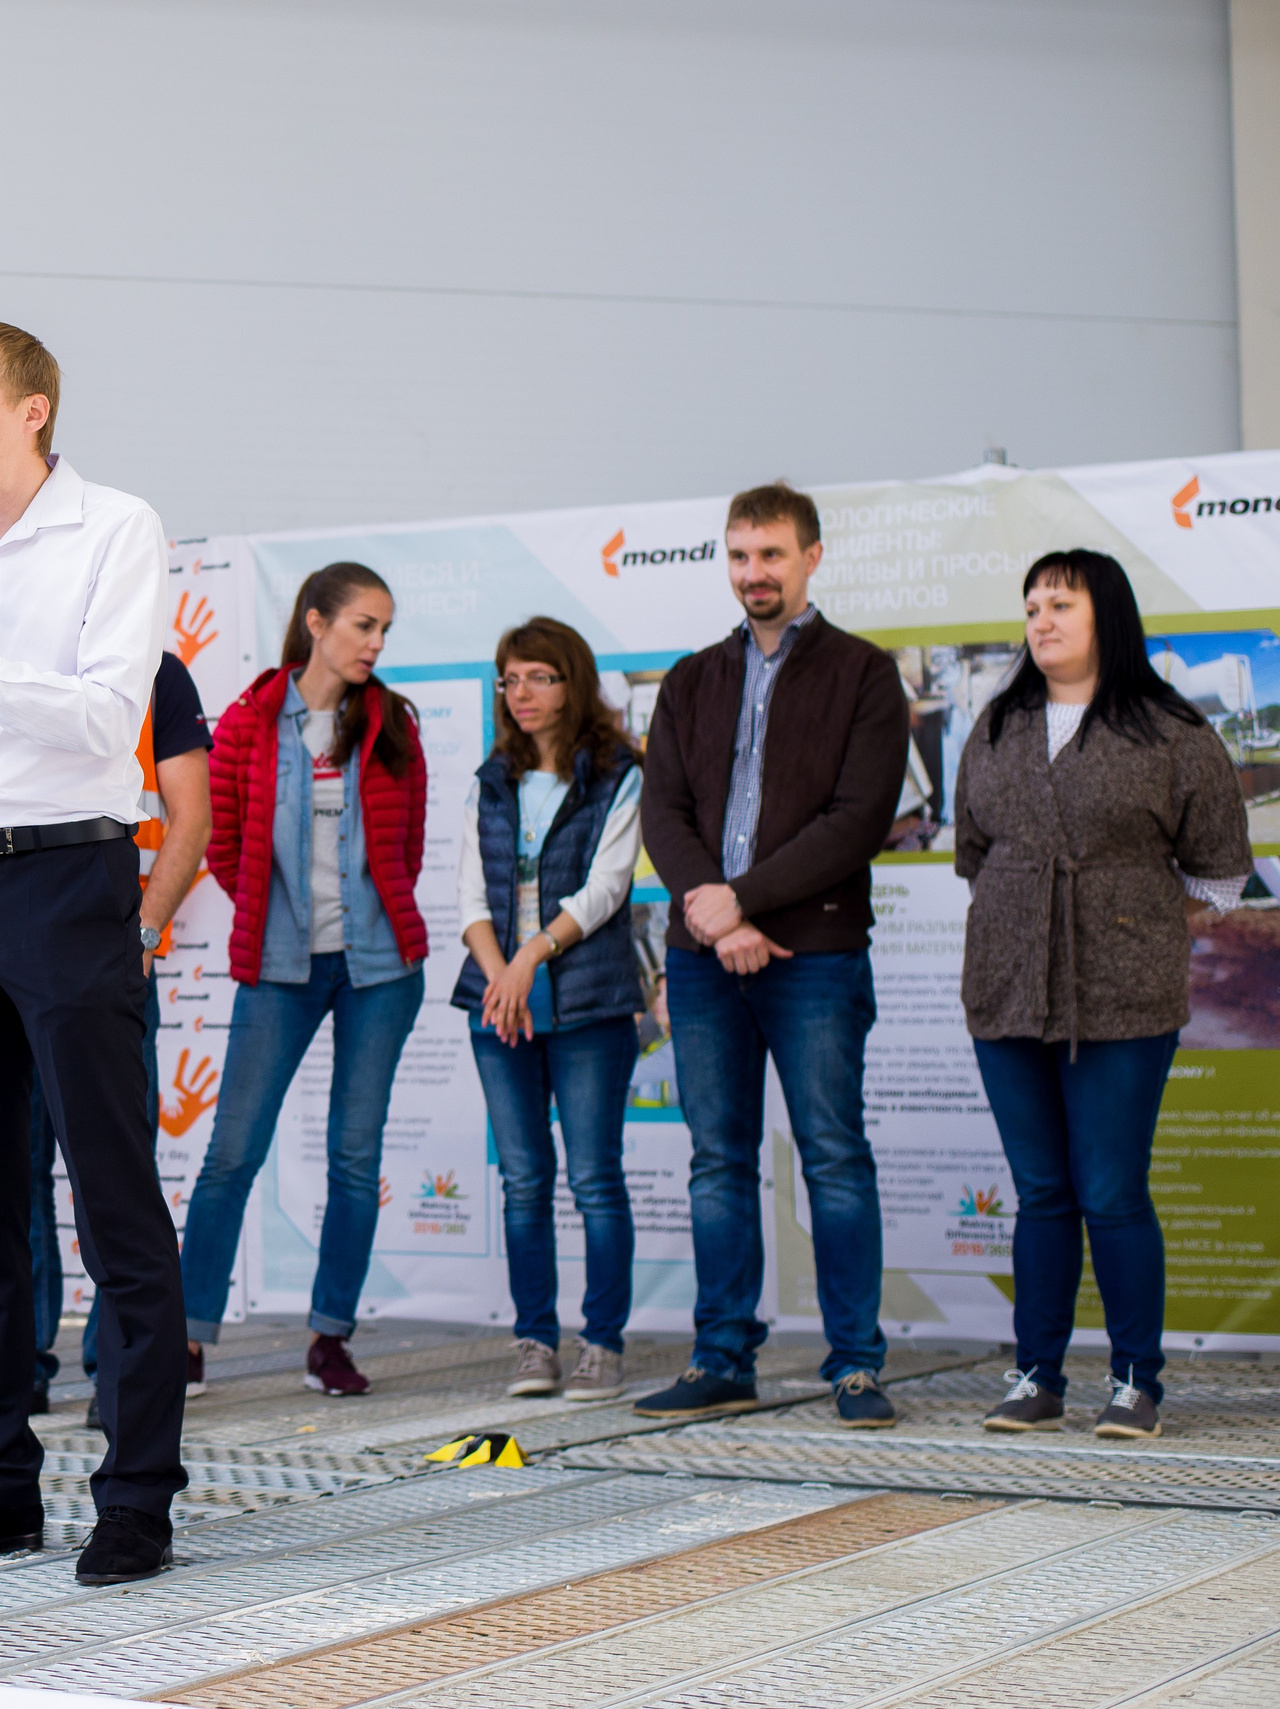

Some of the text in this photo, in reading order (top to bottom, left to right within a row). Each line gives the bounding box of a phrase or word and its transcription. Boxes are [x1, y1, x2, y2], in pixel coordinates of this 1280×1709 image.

[820, 495, 997, 531] ОЛОГИЧЕСКИЕ
[621, 540, 718, 567] mondi
[823, 528, 942, 561] ЦИДЕНТЫ:
[809, 550, 1045, 589] ЗЛИВЫ И ПРОСЫП
[809, 584, 949, 614] ТЕРИАЛОВ
